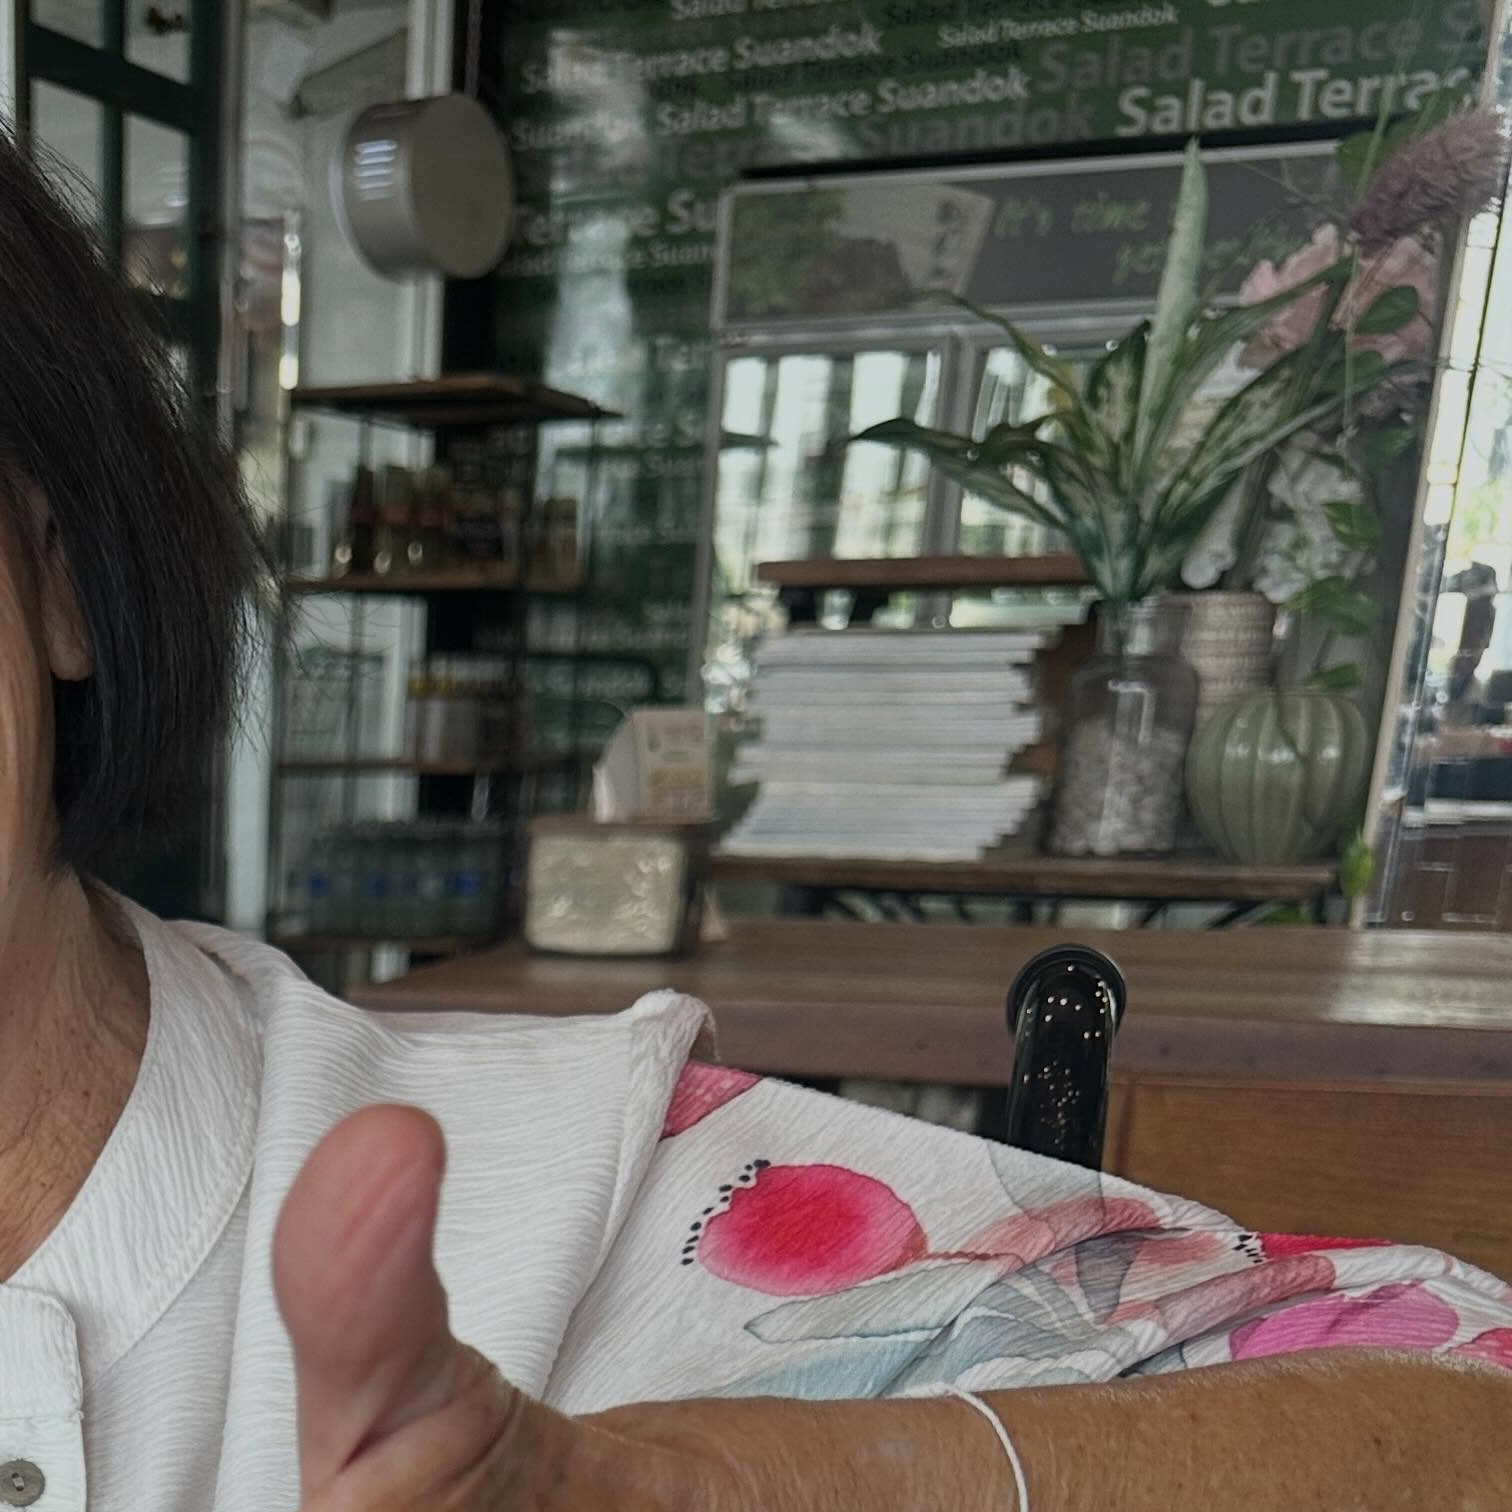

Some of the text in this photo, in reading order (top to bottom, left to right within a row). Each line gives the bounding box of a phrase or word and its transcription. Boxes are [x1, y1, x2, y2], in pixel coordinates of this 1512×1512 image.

[732, 23, 883, 71] Suandok
[1035, 24, 1194, 93] Salad
[1207, 17, 1422, 77] Terrace
[654, 97, 748, 137] Salad
[875, 64, 1031, 114] Suandok
[857, 97, 1096, 155] Suandok
[1114, 69, 1280, 138] Salad
